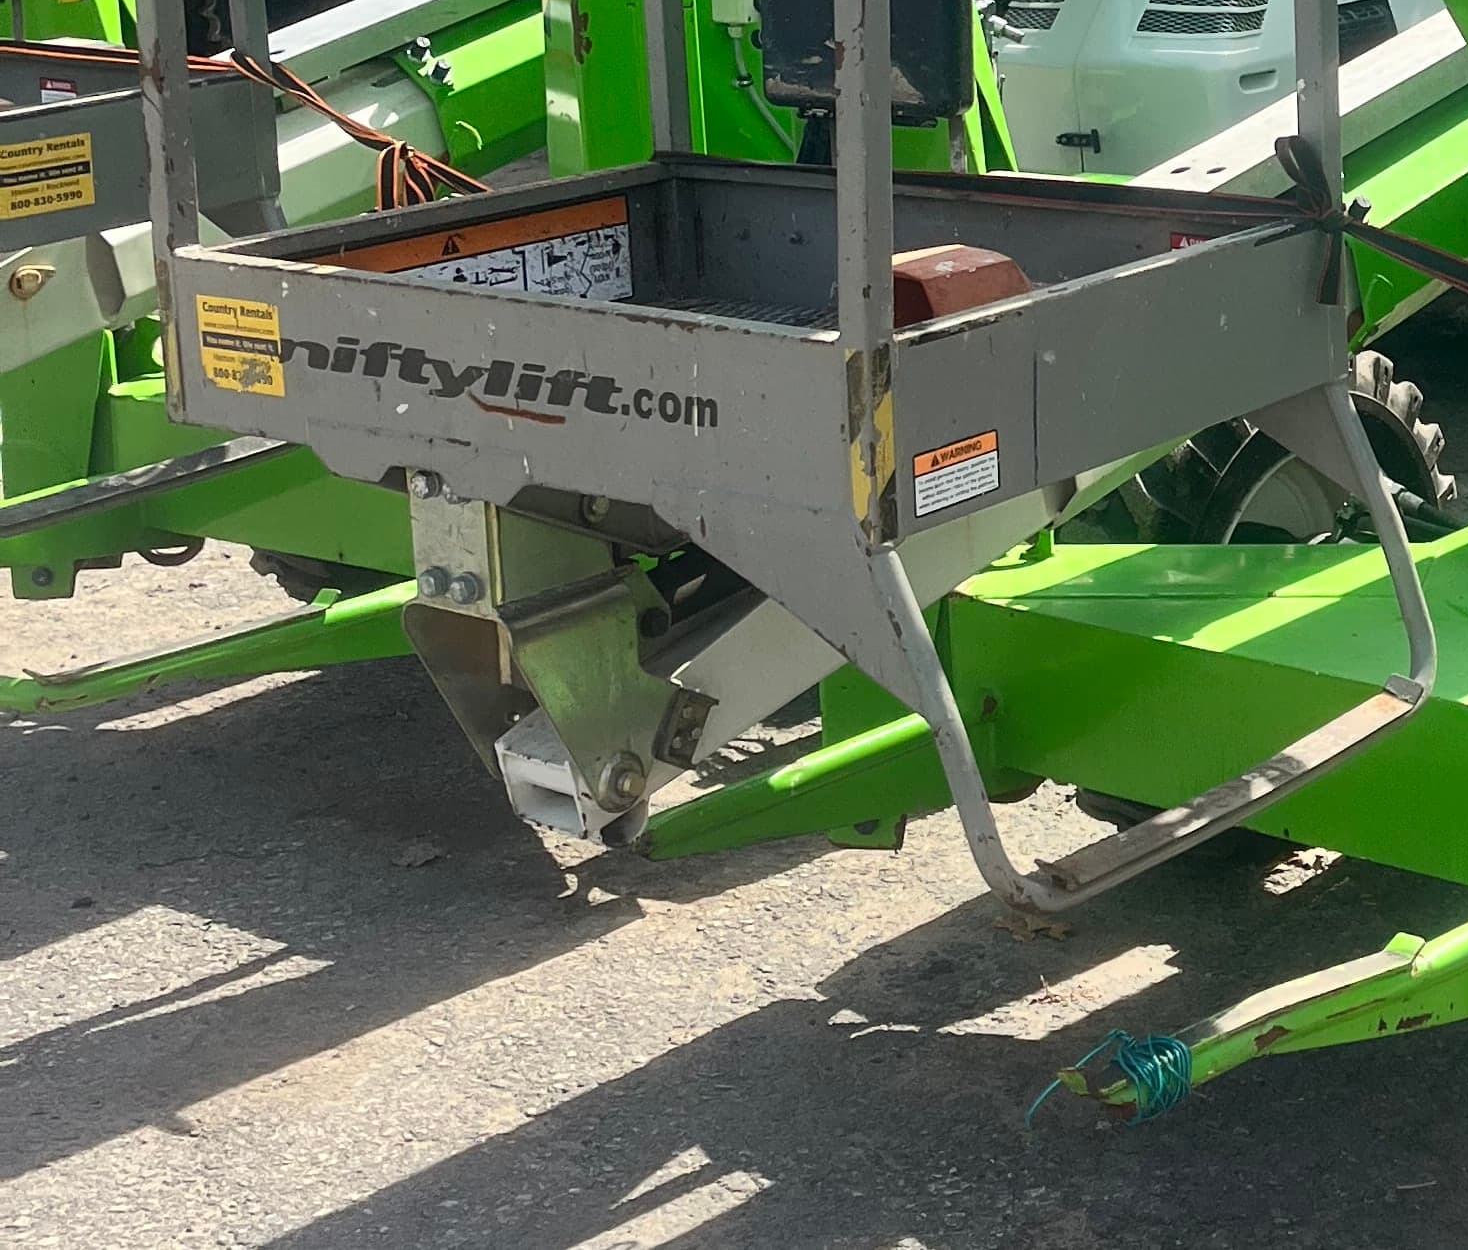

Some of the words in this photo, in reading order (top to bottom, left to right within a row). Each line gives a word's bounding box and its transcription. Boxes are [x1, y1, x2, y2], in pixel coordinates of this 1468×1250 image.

[0, 146, 43, 159] Country
[46, 138, 85, 152] Rentals
[10, 190, 83, 210] 800-830-5990
[202, 301, 238, 319] Country
[240, 306, 273, 320] Rentals
[279, 336, 718, 428] niftylift.com
[940, 440, 982, 462] WARNING
